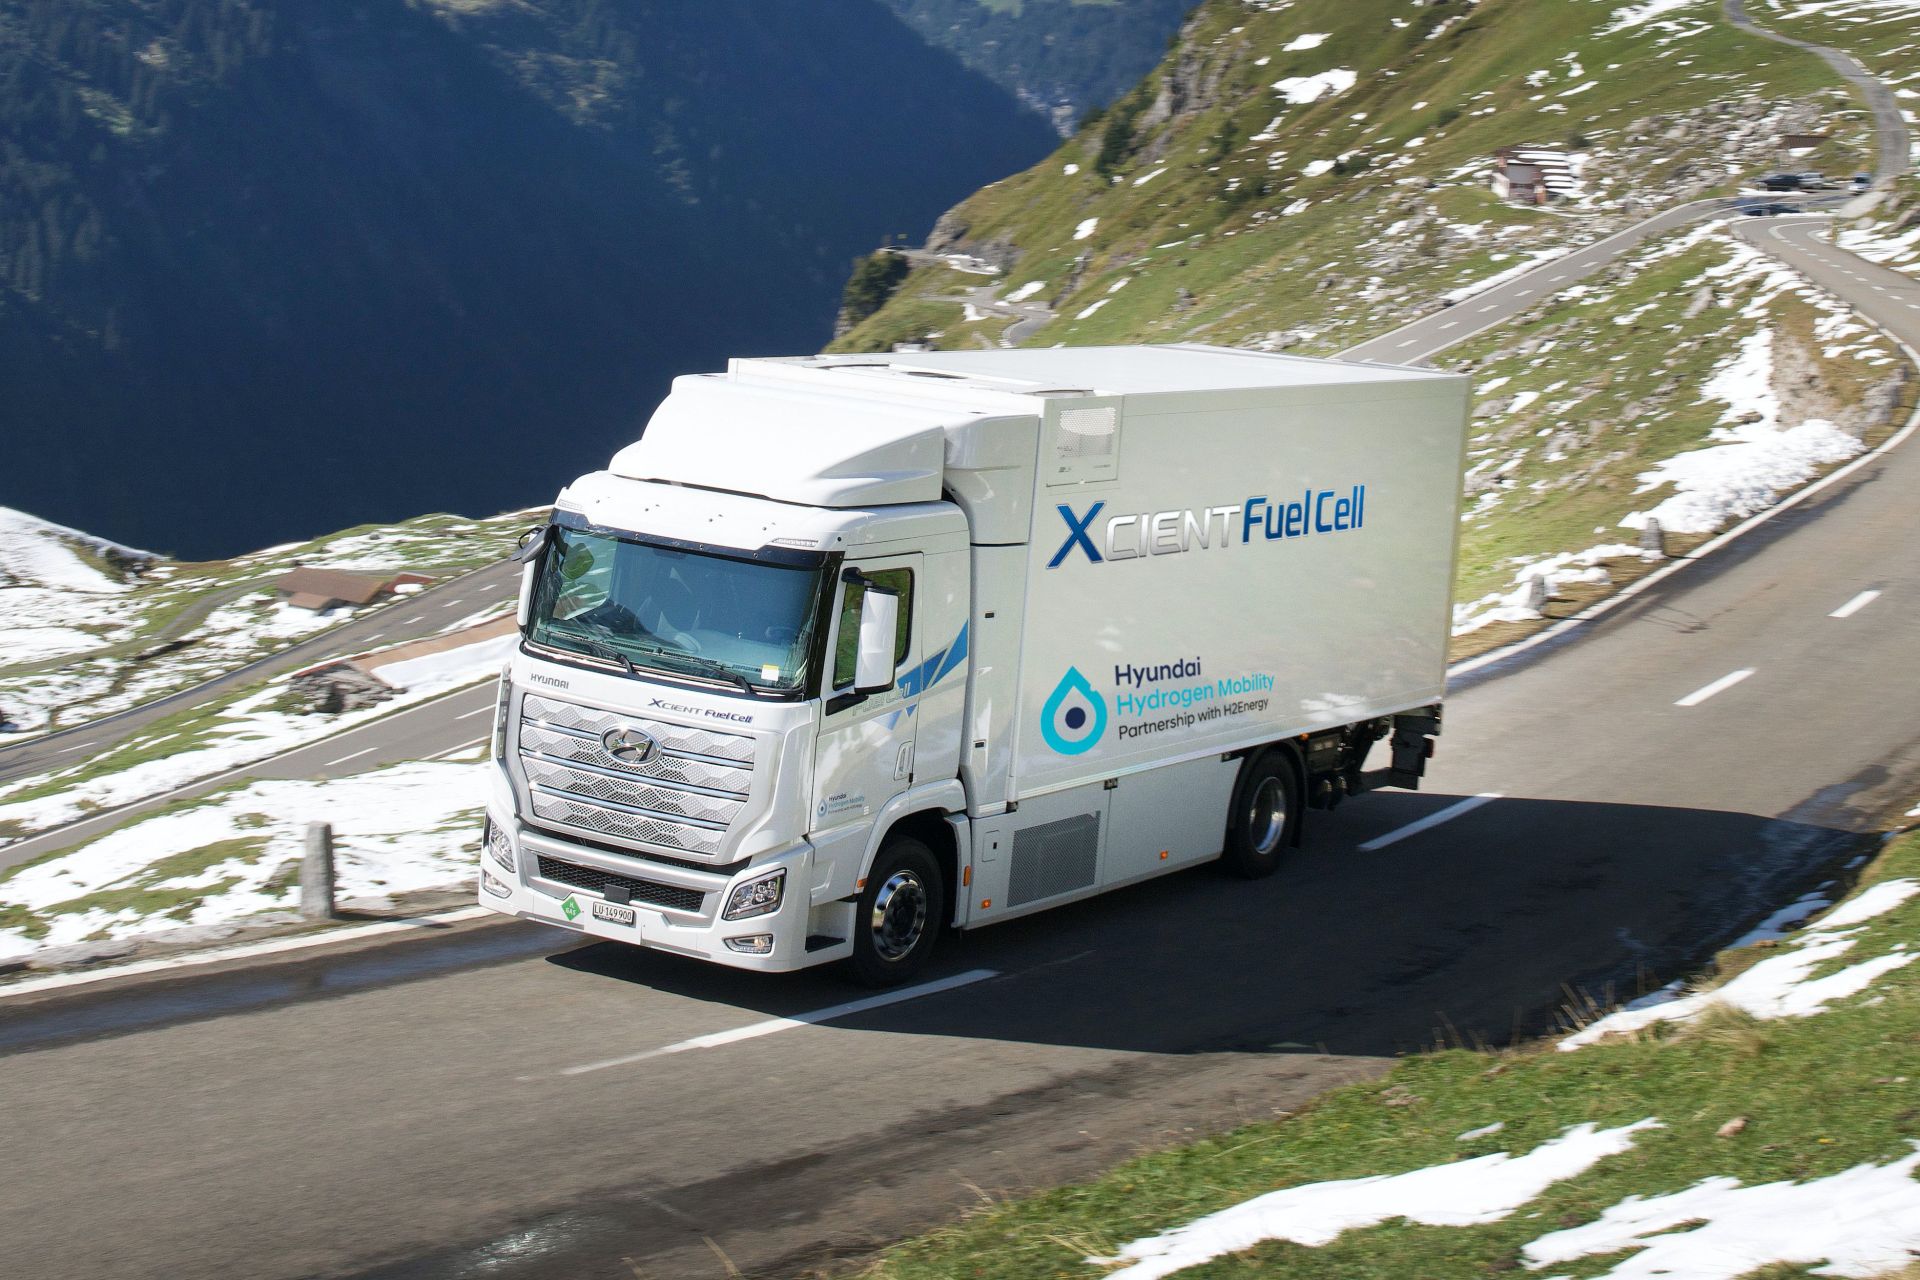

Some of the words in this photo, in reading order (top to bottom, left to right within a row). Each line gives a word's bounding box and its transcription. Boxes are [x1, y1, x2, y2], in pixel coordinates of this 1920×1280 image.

[1045, 500, 1241, 569] XCIENT
[530, 673, 570, 690] HYUNDAI
[1115, 656, 1201, 688] Hyundai
[648, 698, 702, 714] XCIENT
[1117, 684, 1214, 717] Hydrogen
[1218, 673, 1275, 697] Mobility
[1119, 711, 1195, 740] Partnership
[1199, 707, 1221, 722] with
[1223, 699, 1269, 716] H2Energy
[594, 904, 604, 915] LU
